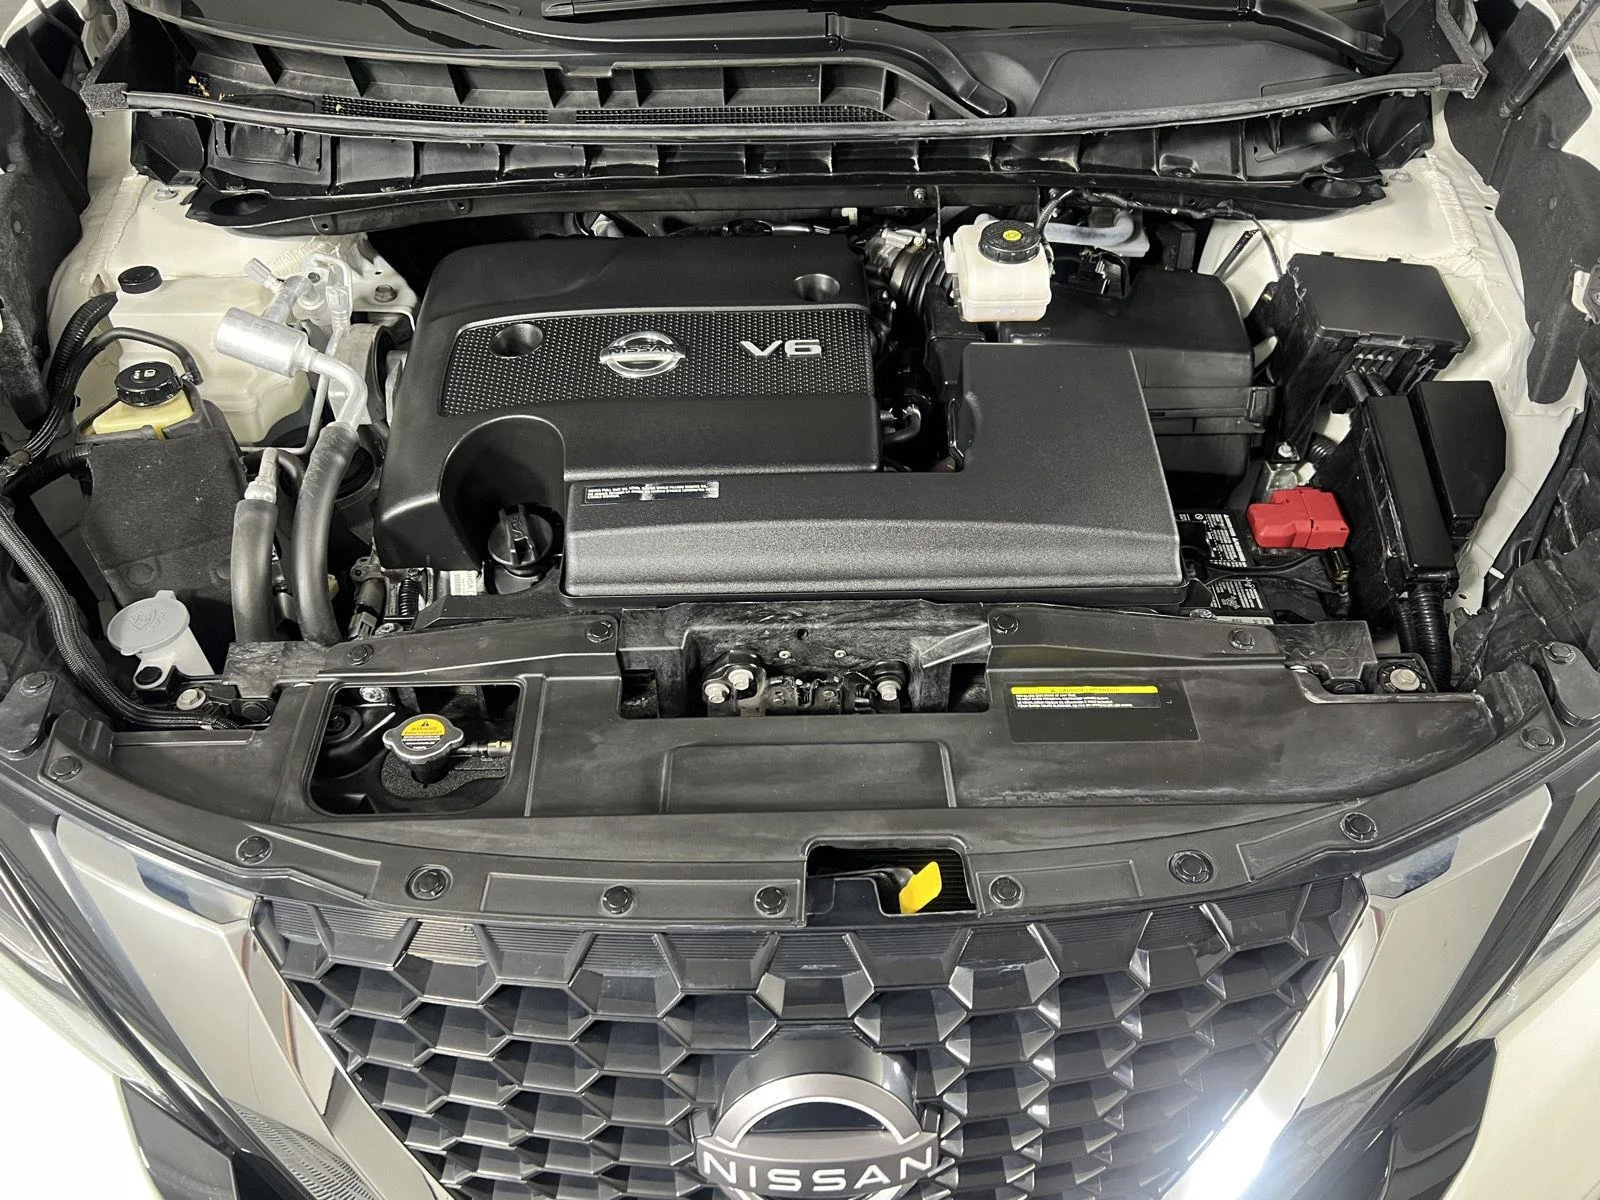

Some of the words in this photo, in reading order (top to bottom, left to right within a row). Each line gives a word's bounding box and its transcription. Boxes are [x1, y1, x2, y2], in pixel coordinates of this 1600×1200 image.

[608, 343, 677, 354] NISSAN
[740, 339, 822, 358] V6
[703, 1146, 932, 1192] NISSAN
